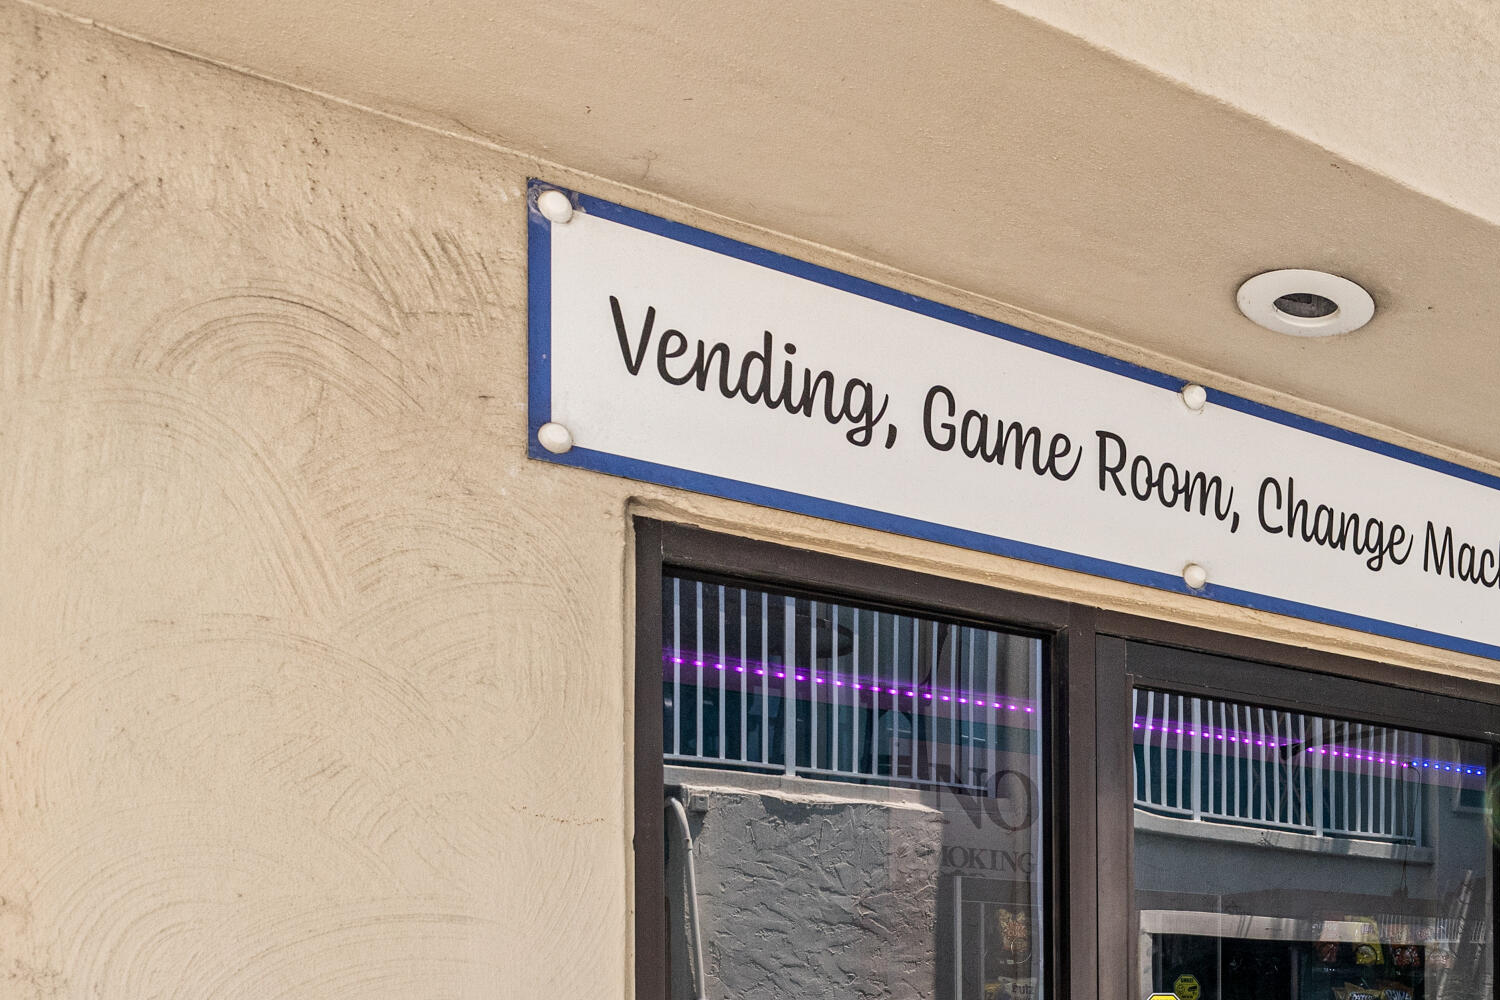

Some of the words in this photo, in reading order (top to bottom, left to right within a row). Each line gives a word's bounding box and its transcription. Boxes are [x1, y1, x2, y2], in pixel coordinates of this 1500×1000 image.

[608, 295, 898, 450] Vending,
[923, 384, 1083, 482] Game
[1095, 430, 1240, 534] Room,
[1257, 476, 1414, 572] Change
[930, 765, 1039, 831] NO
